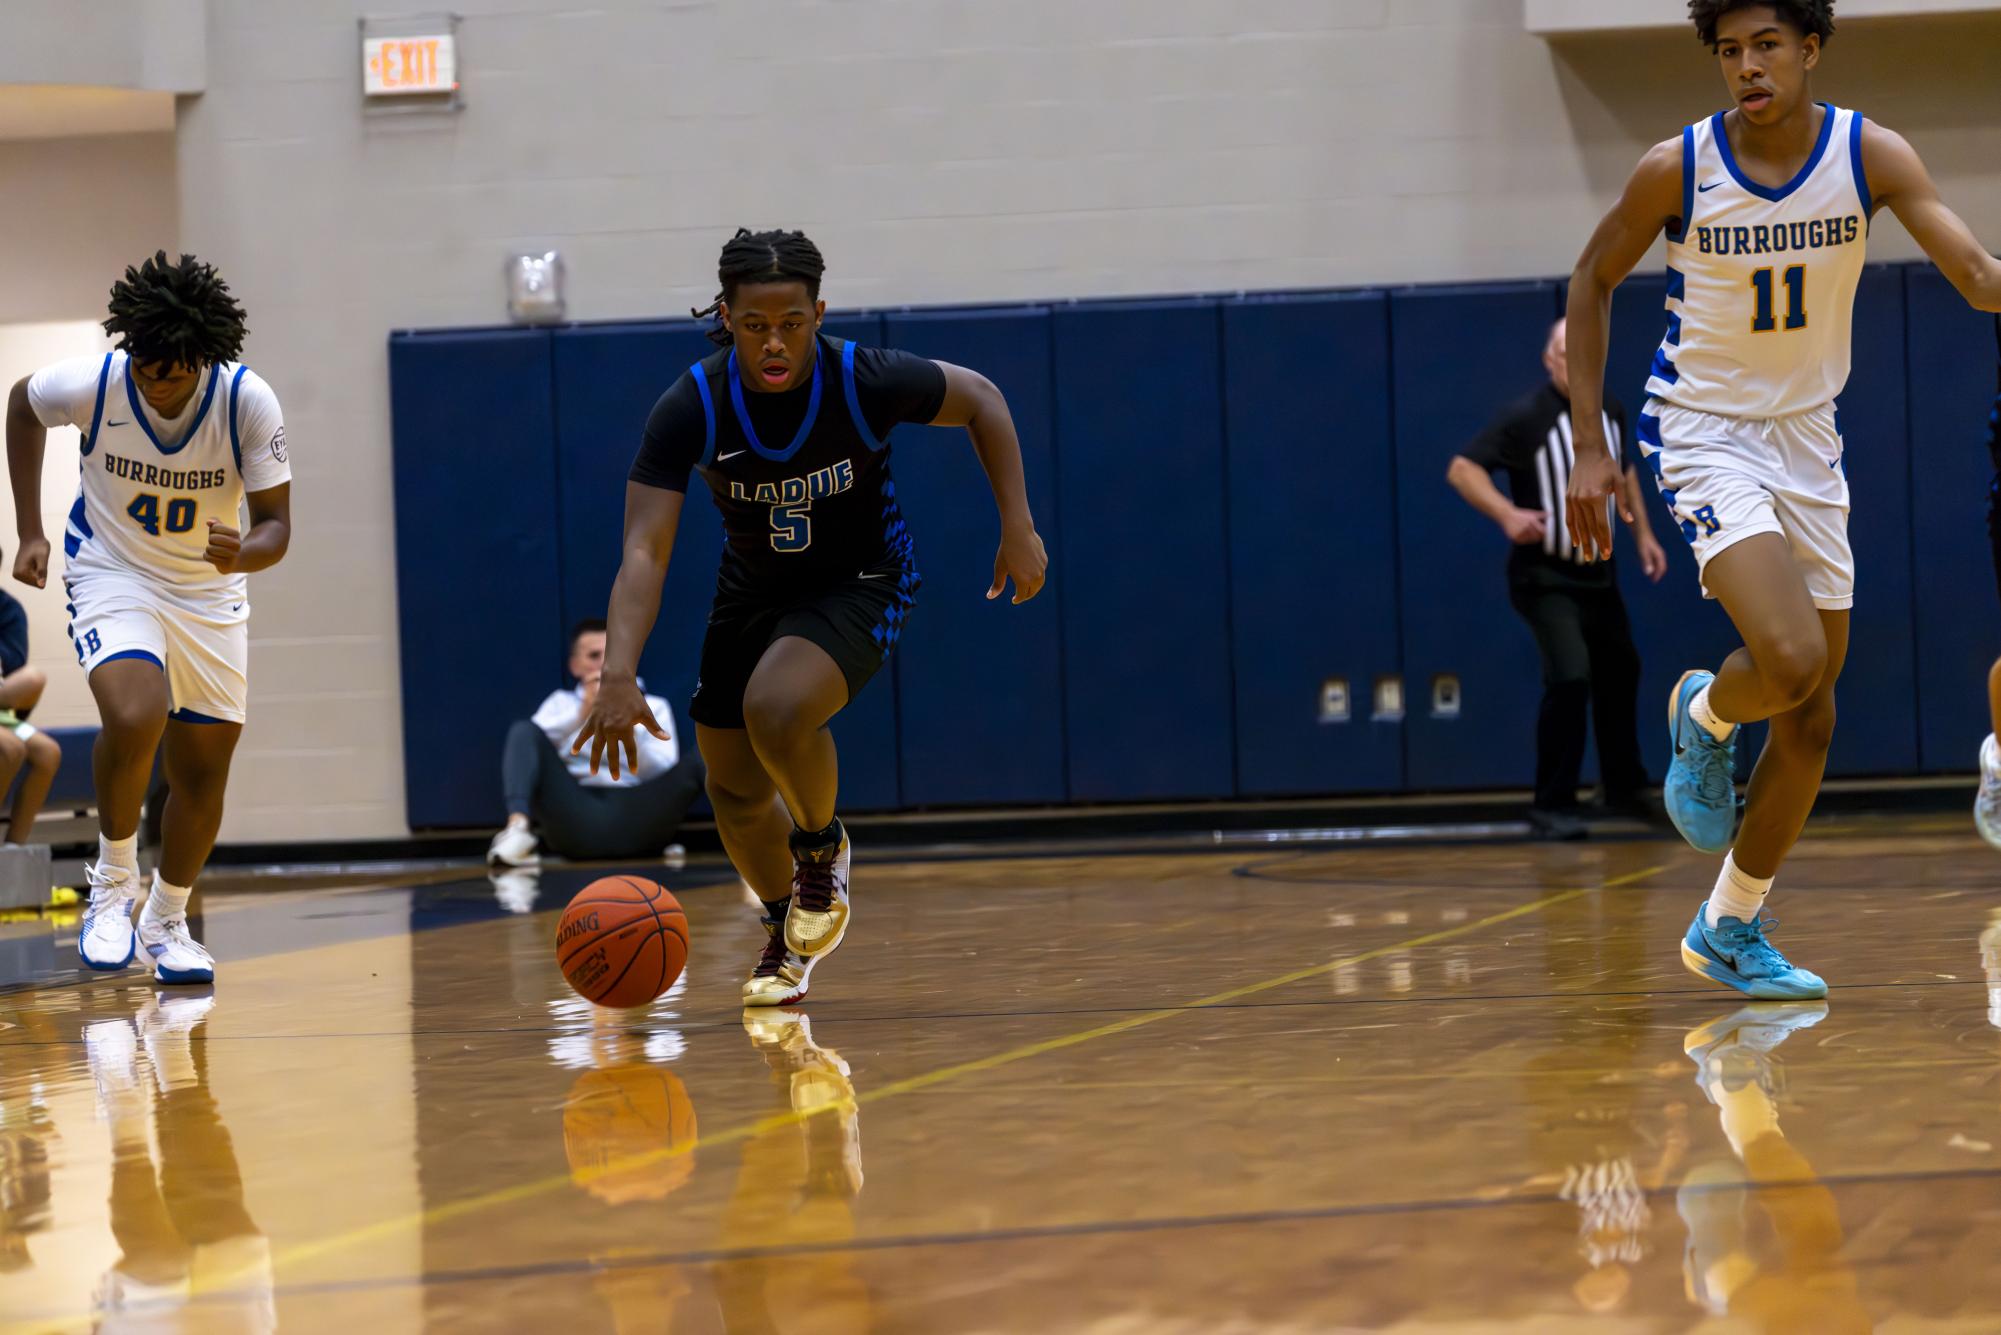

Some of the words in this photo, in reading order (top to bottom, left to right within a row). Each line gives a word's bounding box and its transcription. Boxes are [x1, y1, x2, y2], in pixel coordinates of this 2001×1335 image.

[382, 40, 438, 87] EXIT
[1697, 215, 1858, 255] BURROUGHS
[1750, 263, 1808, 333] 11
[105, 453, 225, 490] BURROUGHS
[731, 458, 853, 504] LADUE
[127, 492, 196, 537] 40
[769, 500, 811, 552] 5
[84, 627, 102, 656] B
